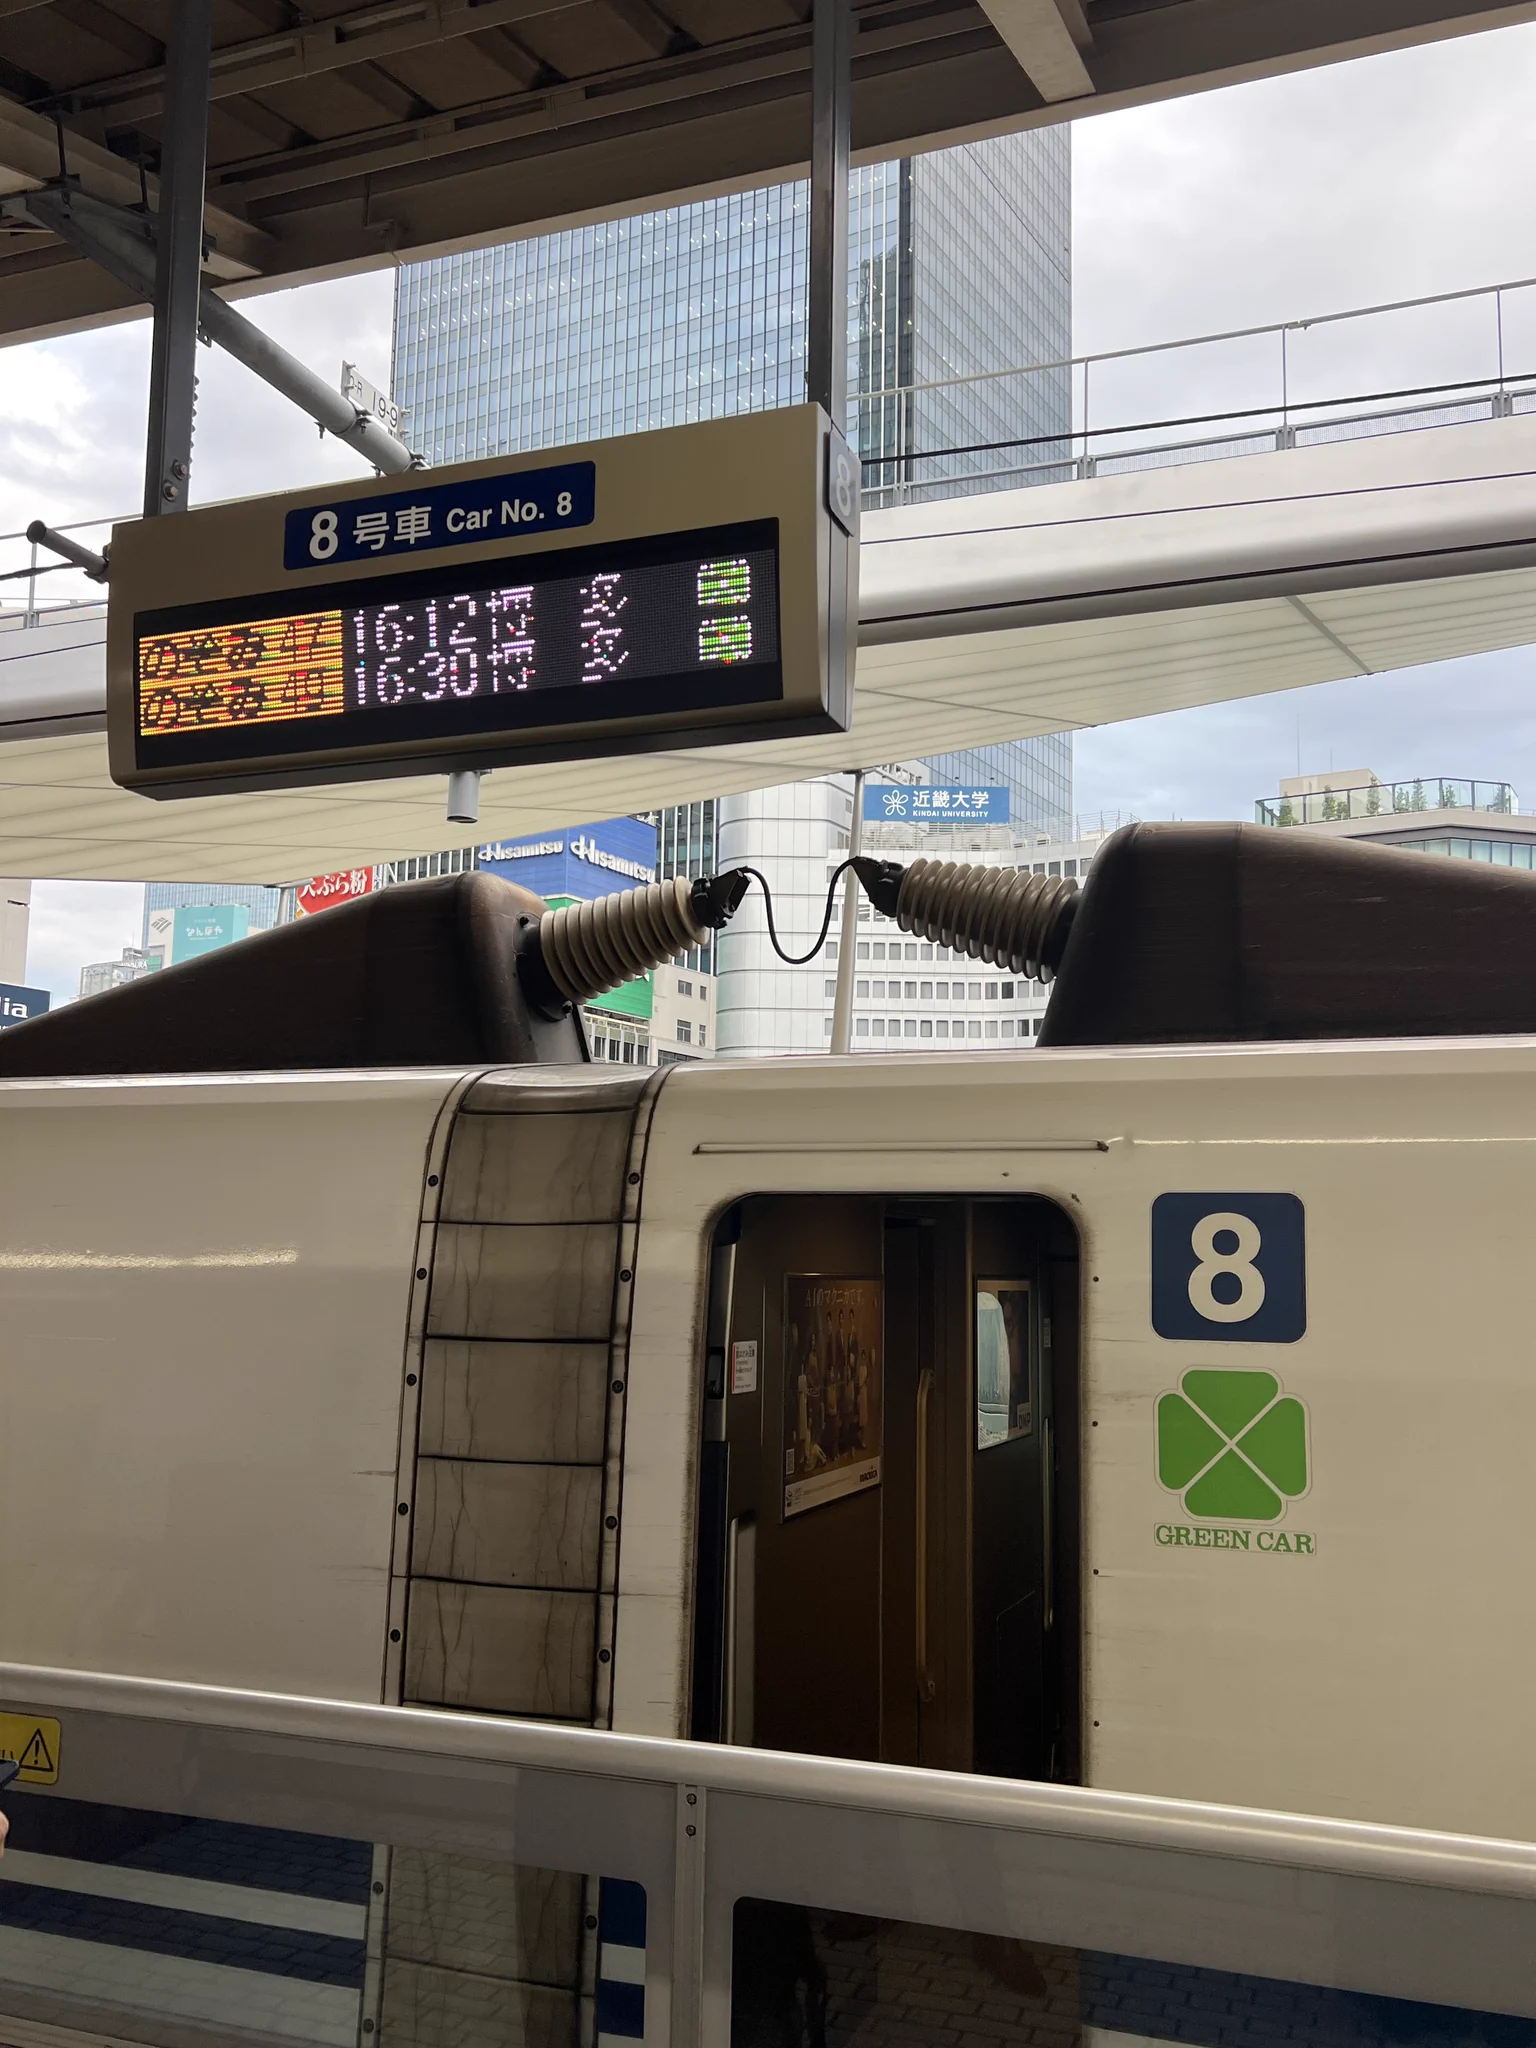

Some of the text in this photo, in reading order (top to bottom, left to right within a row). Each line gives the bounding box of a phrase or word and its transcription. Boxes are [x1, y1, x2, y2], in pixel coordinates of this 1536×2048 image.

[836, 453, 852, 517] 8
[446, 507, 492, 533] Car
[501, 499, 545, 525] No.
[556, 491, 572, 516] 8
[353, 596, 477, 655] 16:12
[355, 648, 478, 704] 16:30
[912, 790, 990, 809] 近畿大学
[942, 810, 988, 818] UNIVERSITY
[478, 840, 564, 862] Hisamitsu
[569, 834, 656, 883] Hisamitsu
[1188, 1212, 1265, 1323] 8
[1156, 1525, 1314, 1554] GREEN CAR
